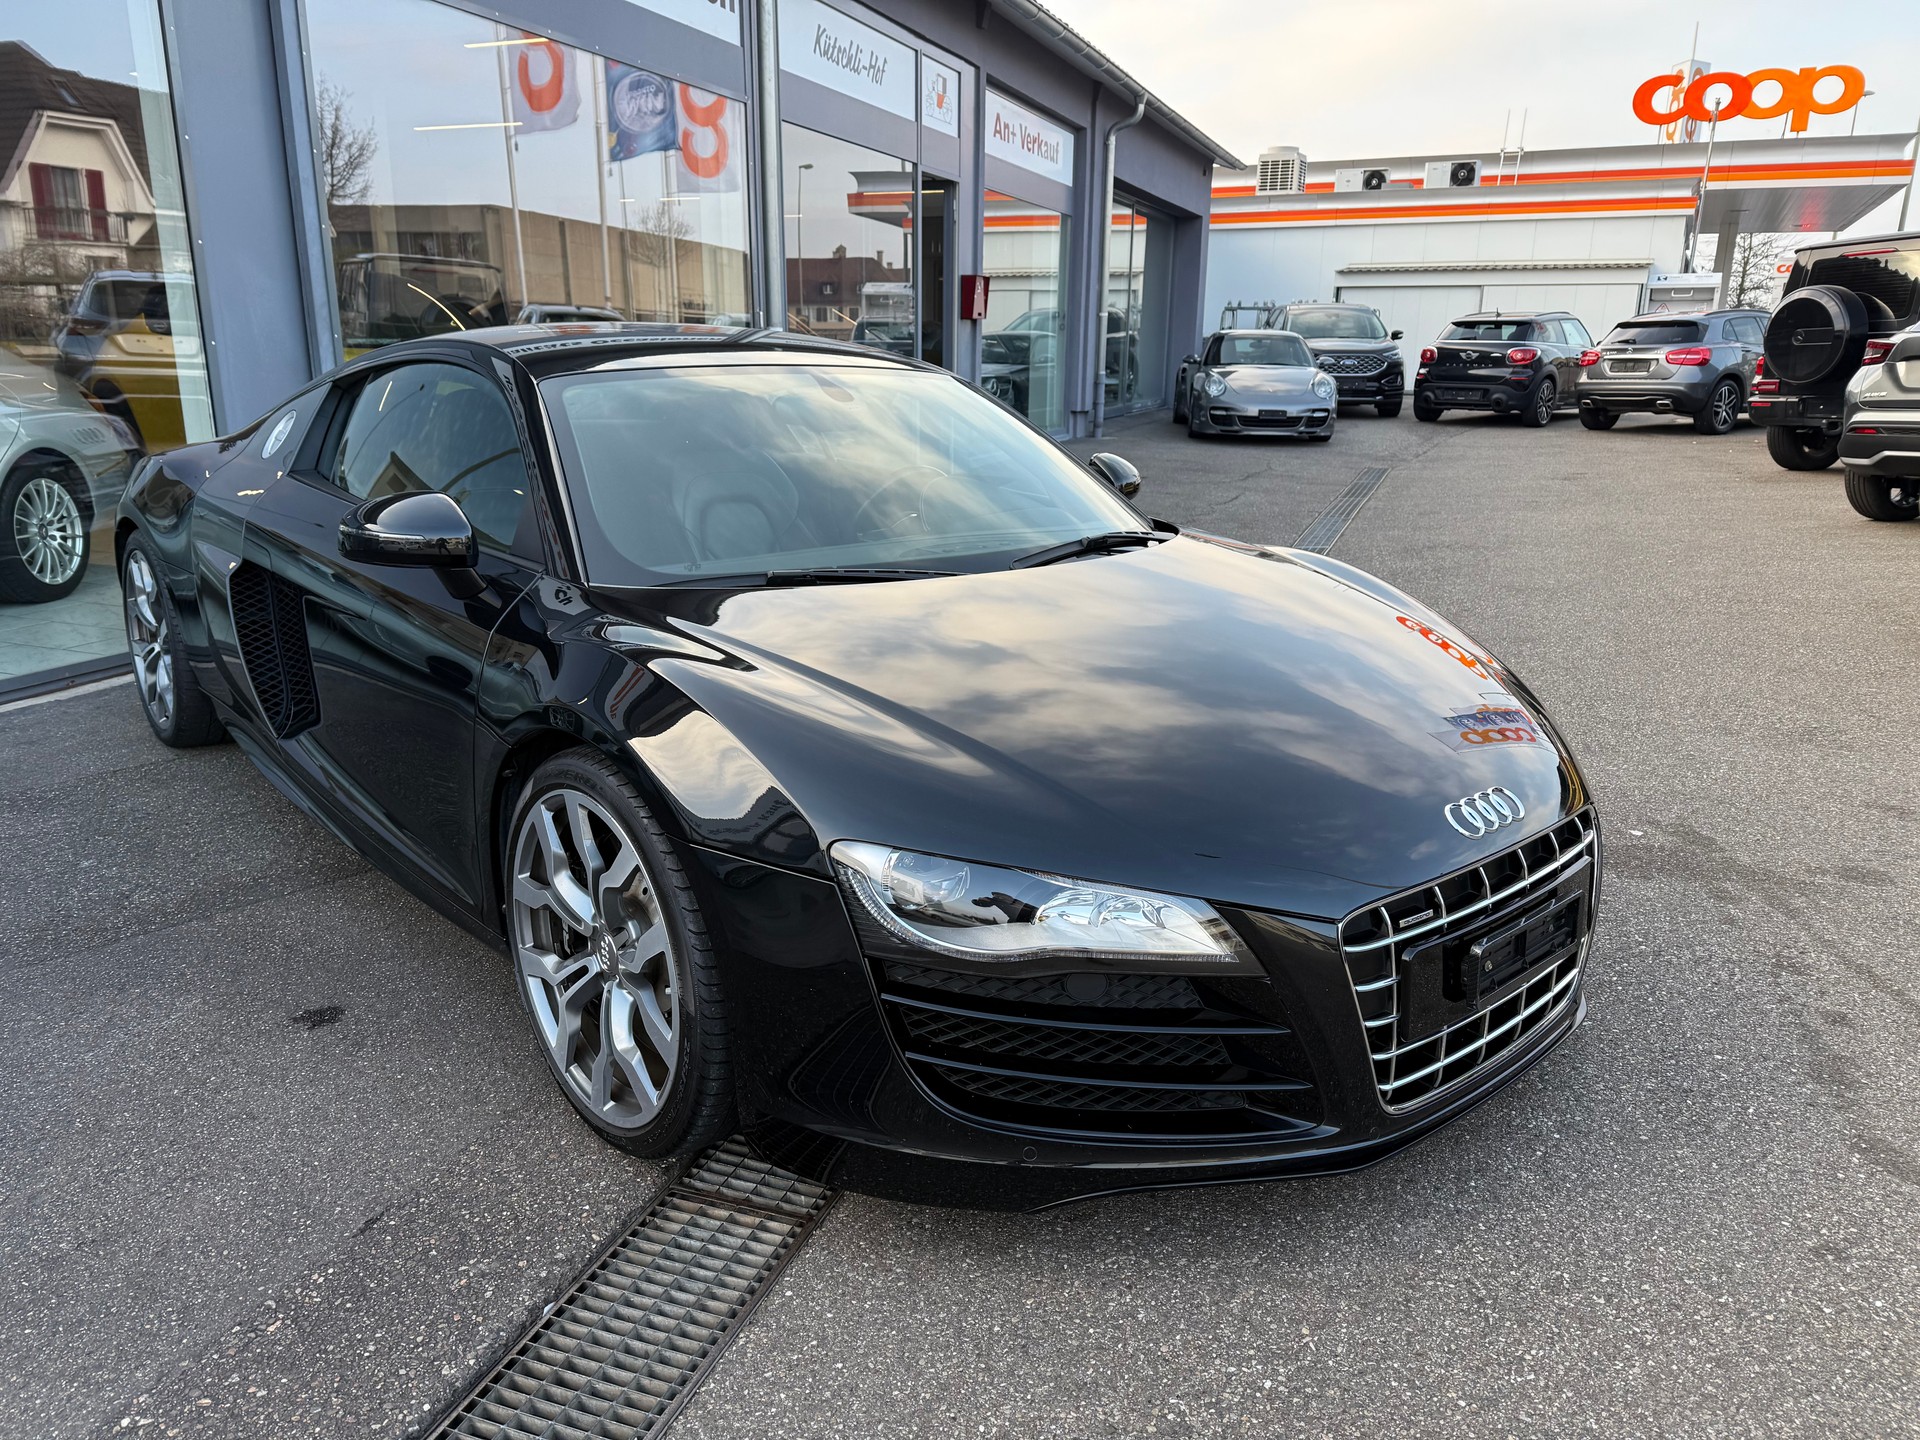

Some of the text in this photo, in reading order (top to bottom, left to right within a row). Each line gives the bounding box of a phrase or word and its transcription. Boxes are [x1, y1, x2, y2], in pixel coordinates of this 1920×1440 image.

[813, 23, 888, 86] Kütschli-Hof
[1632, 64, 1866, 132] coop
[1019, 123, 1059, 165] Verkauf
